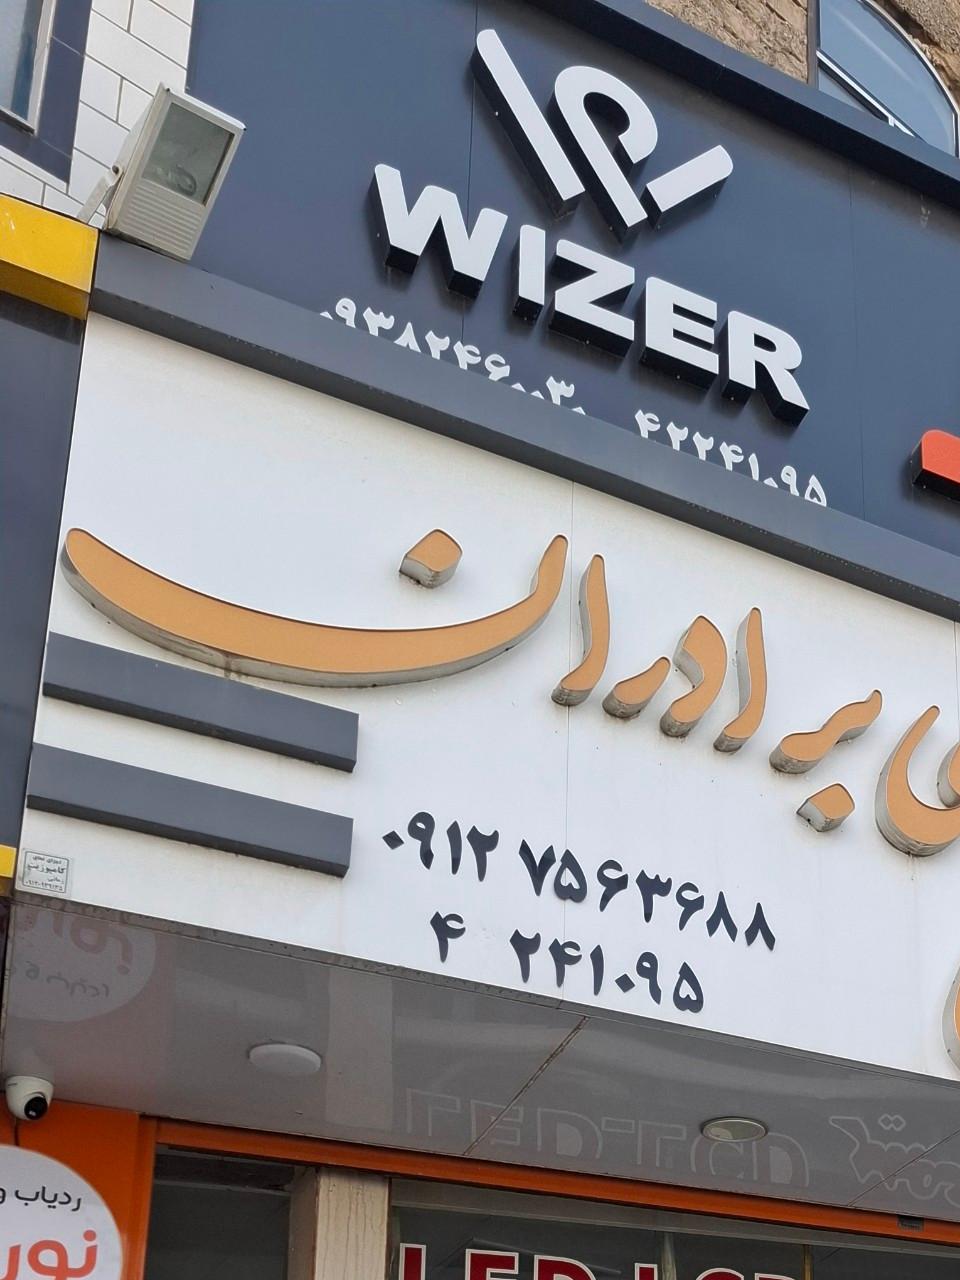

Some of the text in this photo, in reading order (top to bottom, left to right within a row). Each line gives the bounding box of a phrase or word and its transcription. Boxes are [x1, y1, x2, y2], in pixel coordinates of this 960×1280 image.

[374, 164, 810, 425] WIZER
[61, 528, 883, 833] برادران
[382, 811, 776, 952] ۰۹۱۲ ۷۵۶۳۶۸۸
[509, 929, 705, 1014] ۲۴۱۰۹۵
[15, 1186, 82, 1212] ردیاب
